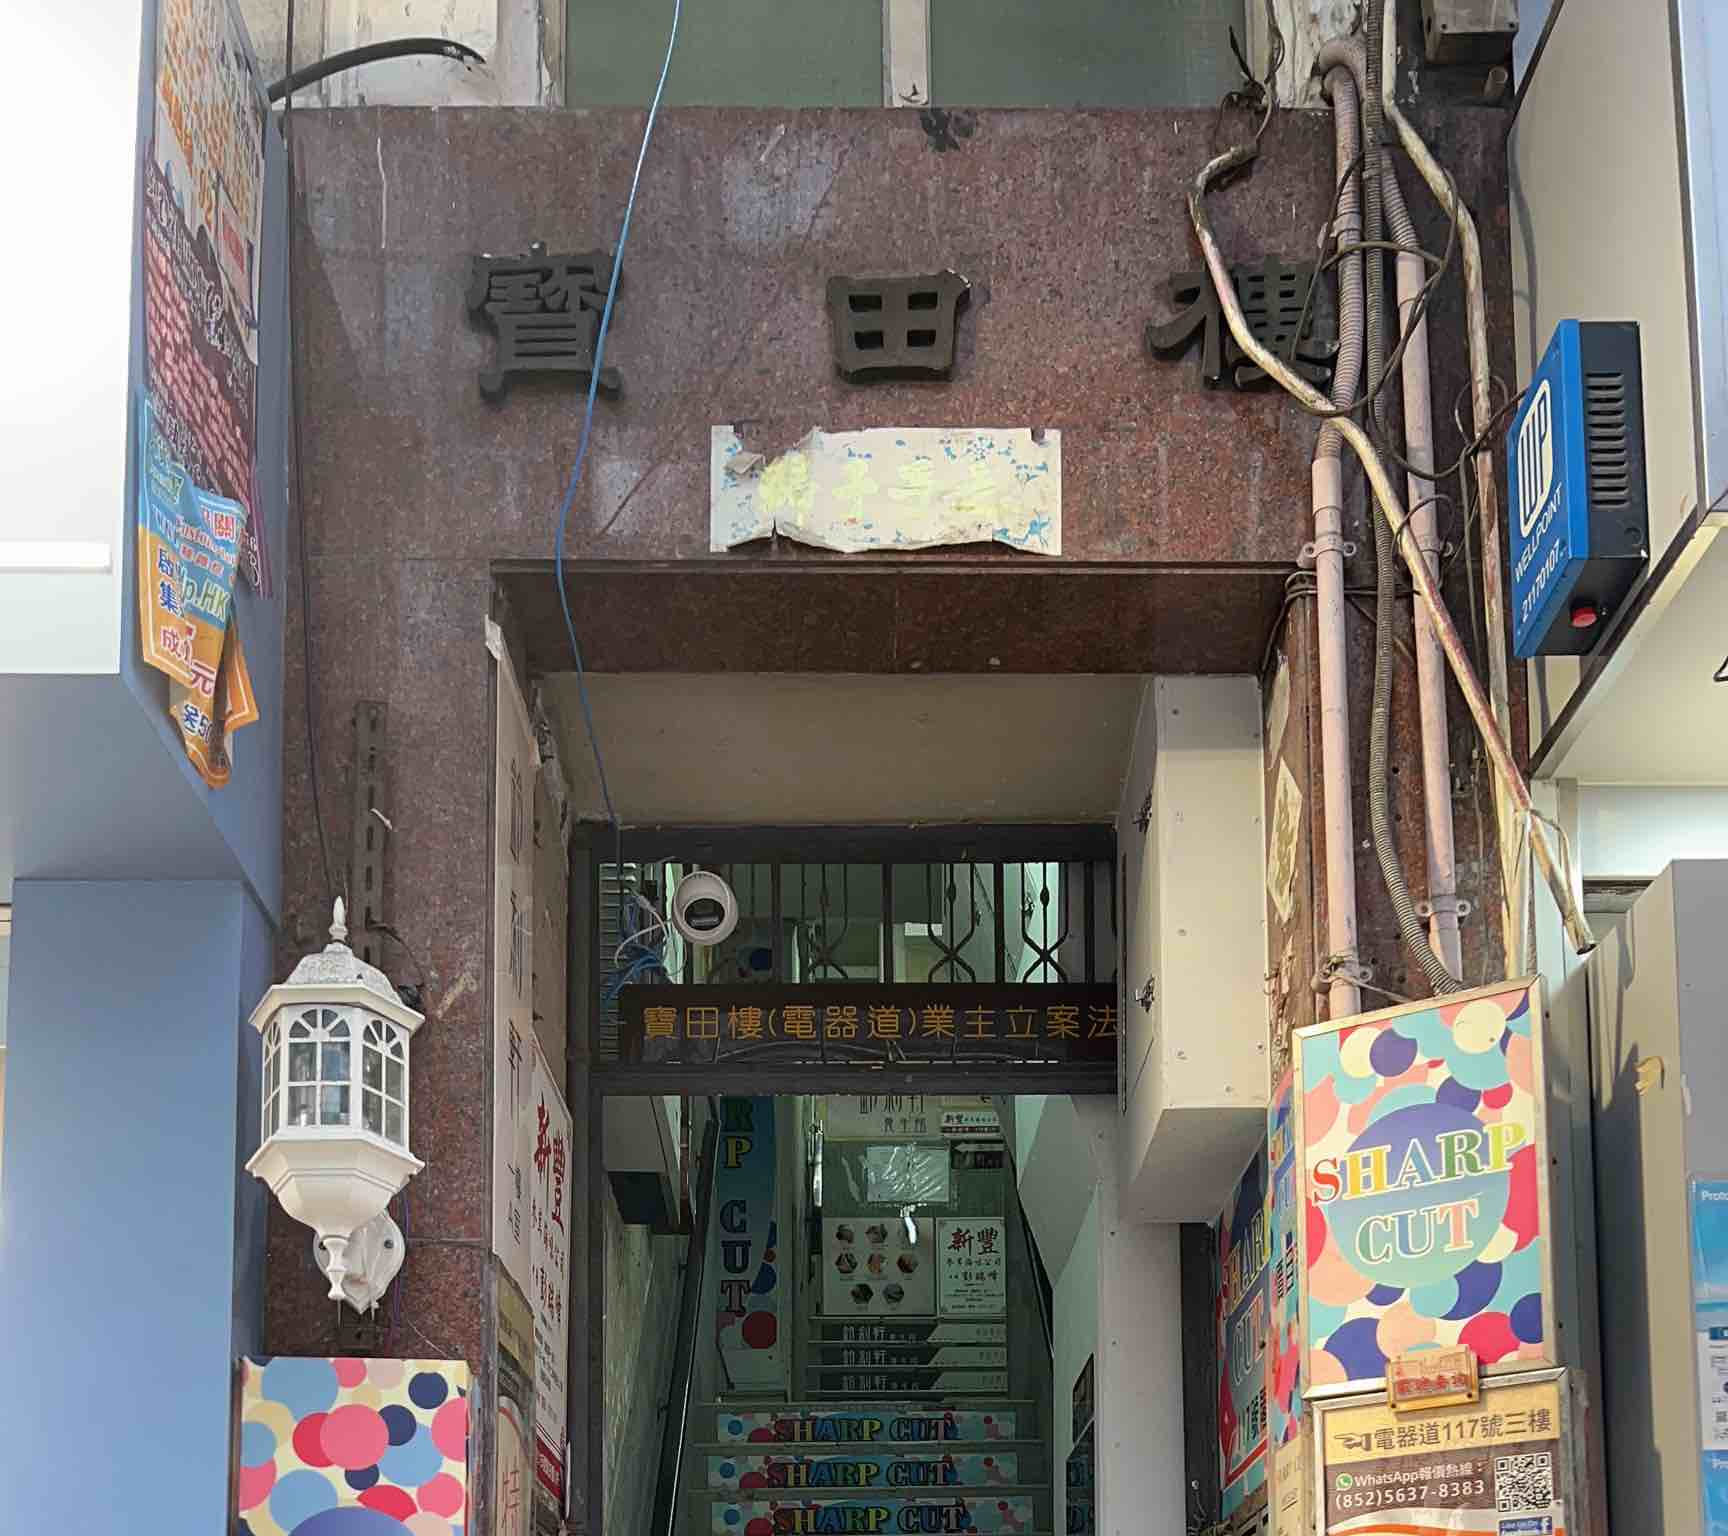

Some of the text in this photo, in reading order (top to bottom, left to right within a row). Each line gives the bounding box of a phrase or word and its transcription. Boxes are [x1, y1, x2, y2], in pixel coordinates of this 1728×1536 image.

[1515, 481, 1563, 583] WELLPOINT
[1312, 1120, 1527, 1206] SHARP
[1354, 1199, 1481, 1266] CUT
[774, 1417, 948, 1442] SHARP CUT
[1374, 1408, 1552, 1450] 電器道117號三樓
[767, 1461, 951, 1487] SHARP CUT
[1335, 1480, 1485, 1509] (852)5637-8383
[773, 1503, 965, 1535] SHARP CUT
